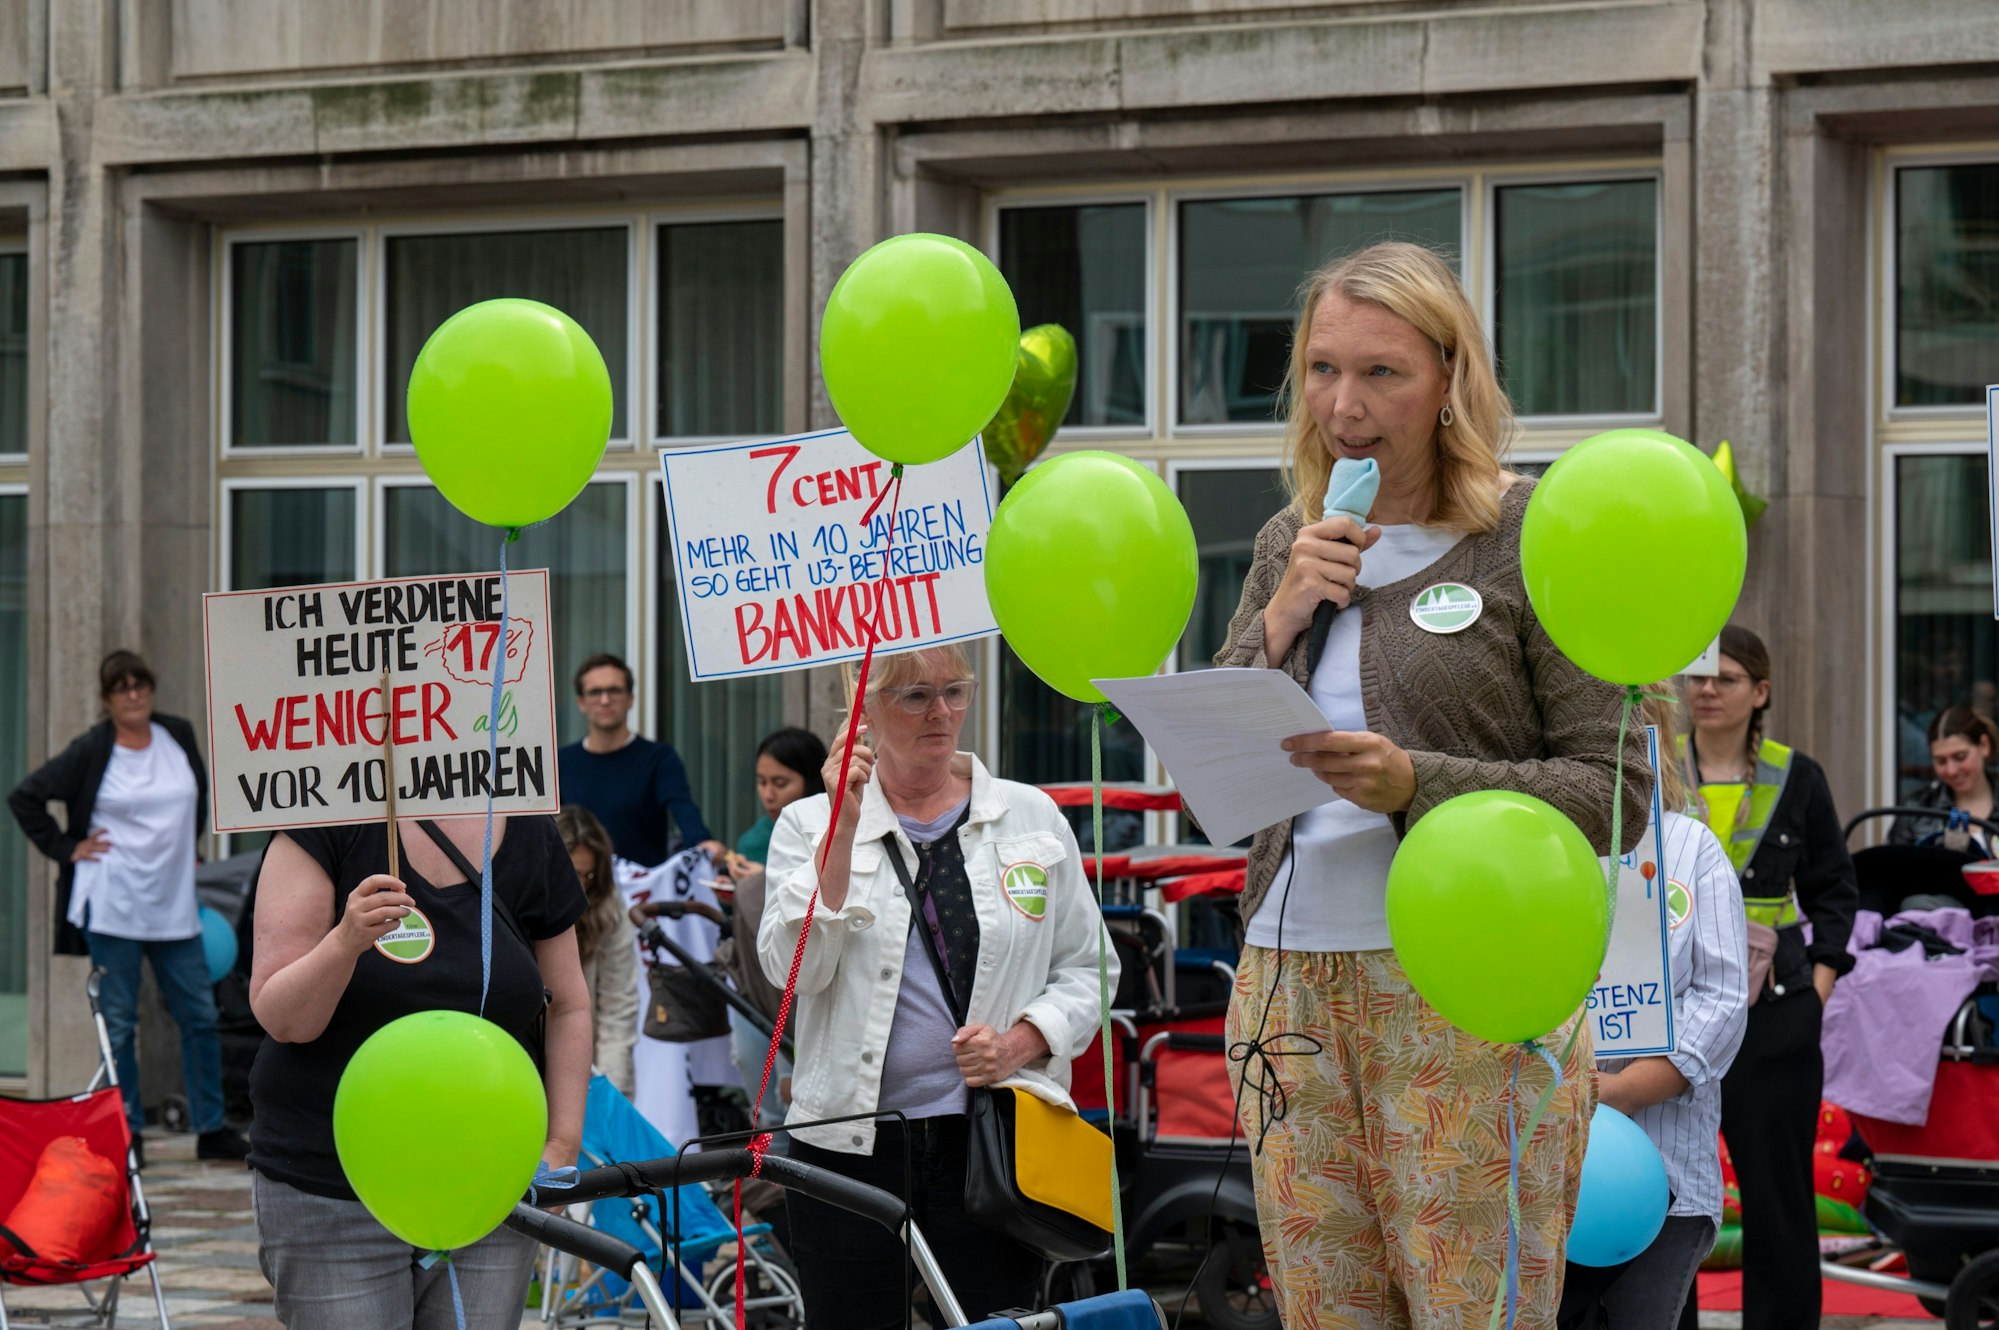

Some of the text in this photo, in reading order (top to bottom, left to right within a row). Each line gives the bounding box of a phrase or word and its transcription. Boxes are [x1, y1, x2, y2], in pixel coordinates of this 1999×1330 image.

[750, 445, 884, 514] 7 CENT
[687, 499, 966, 569] MEHR IN 10 JAHREN
[264, 577, 504, 632] ICH VERDIENE
[691, 573, 729, 598] SO
[735, 564, 792, 592] GEHT
[296, 626, 418, 678] HEUTE
[734, 572, 942, 665] BANKROTT
[234, 682, 518, 752] WENIGER als
[237, 746, 546, 813] VOR 10 JAHREN
[1599, 1010, 1637, 1041] IST
